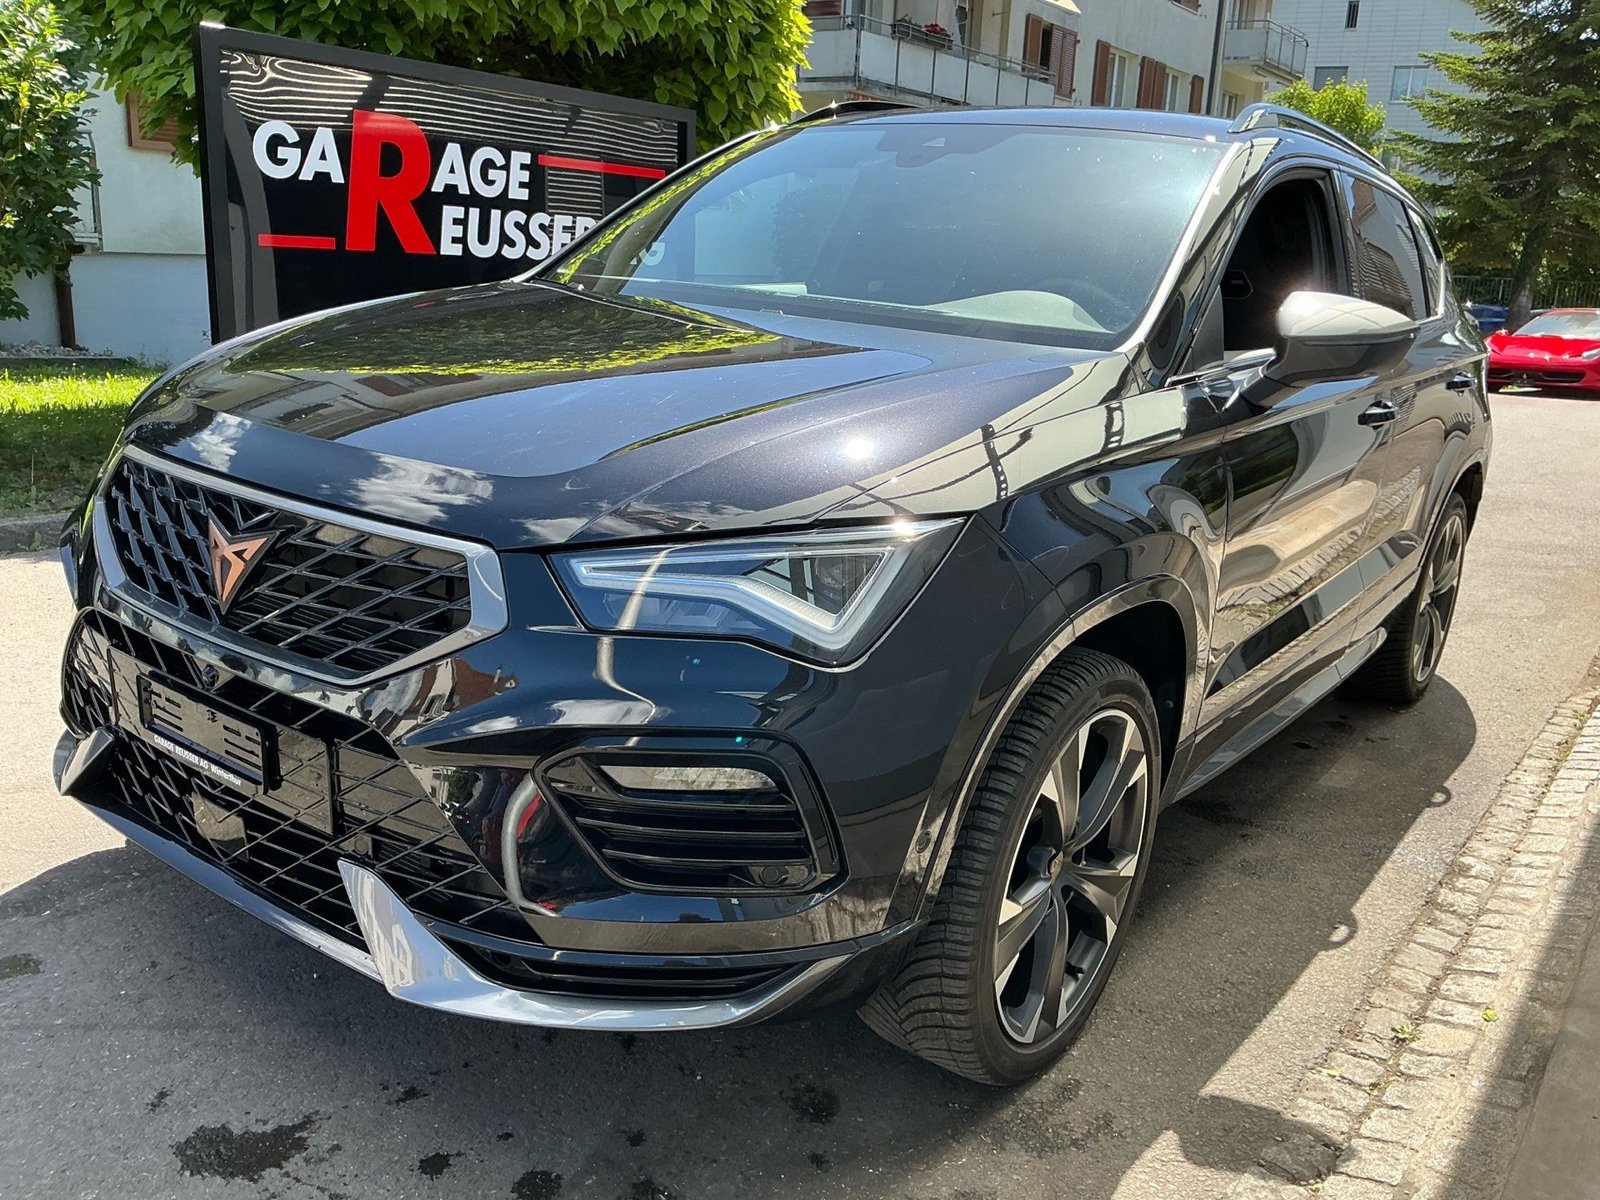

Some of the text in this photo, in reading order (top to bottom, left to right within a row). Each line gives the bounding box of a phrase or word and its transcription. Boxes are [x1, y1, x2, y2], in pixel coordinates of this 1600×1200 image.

[252, 109, 532, 255] GARAGE
[154, 735, 242, 786] GARAGE REUSSER AG Winterthur
